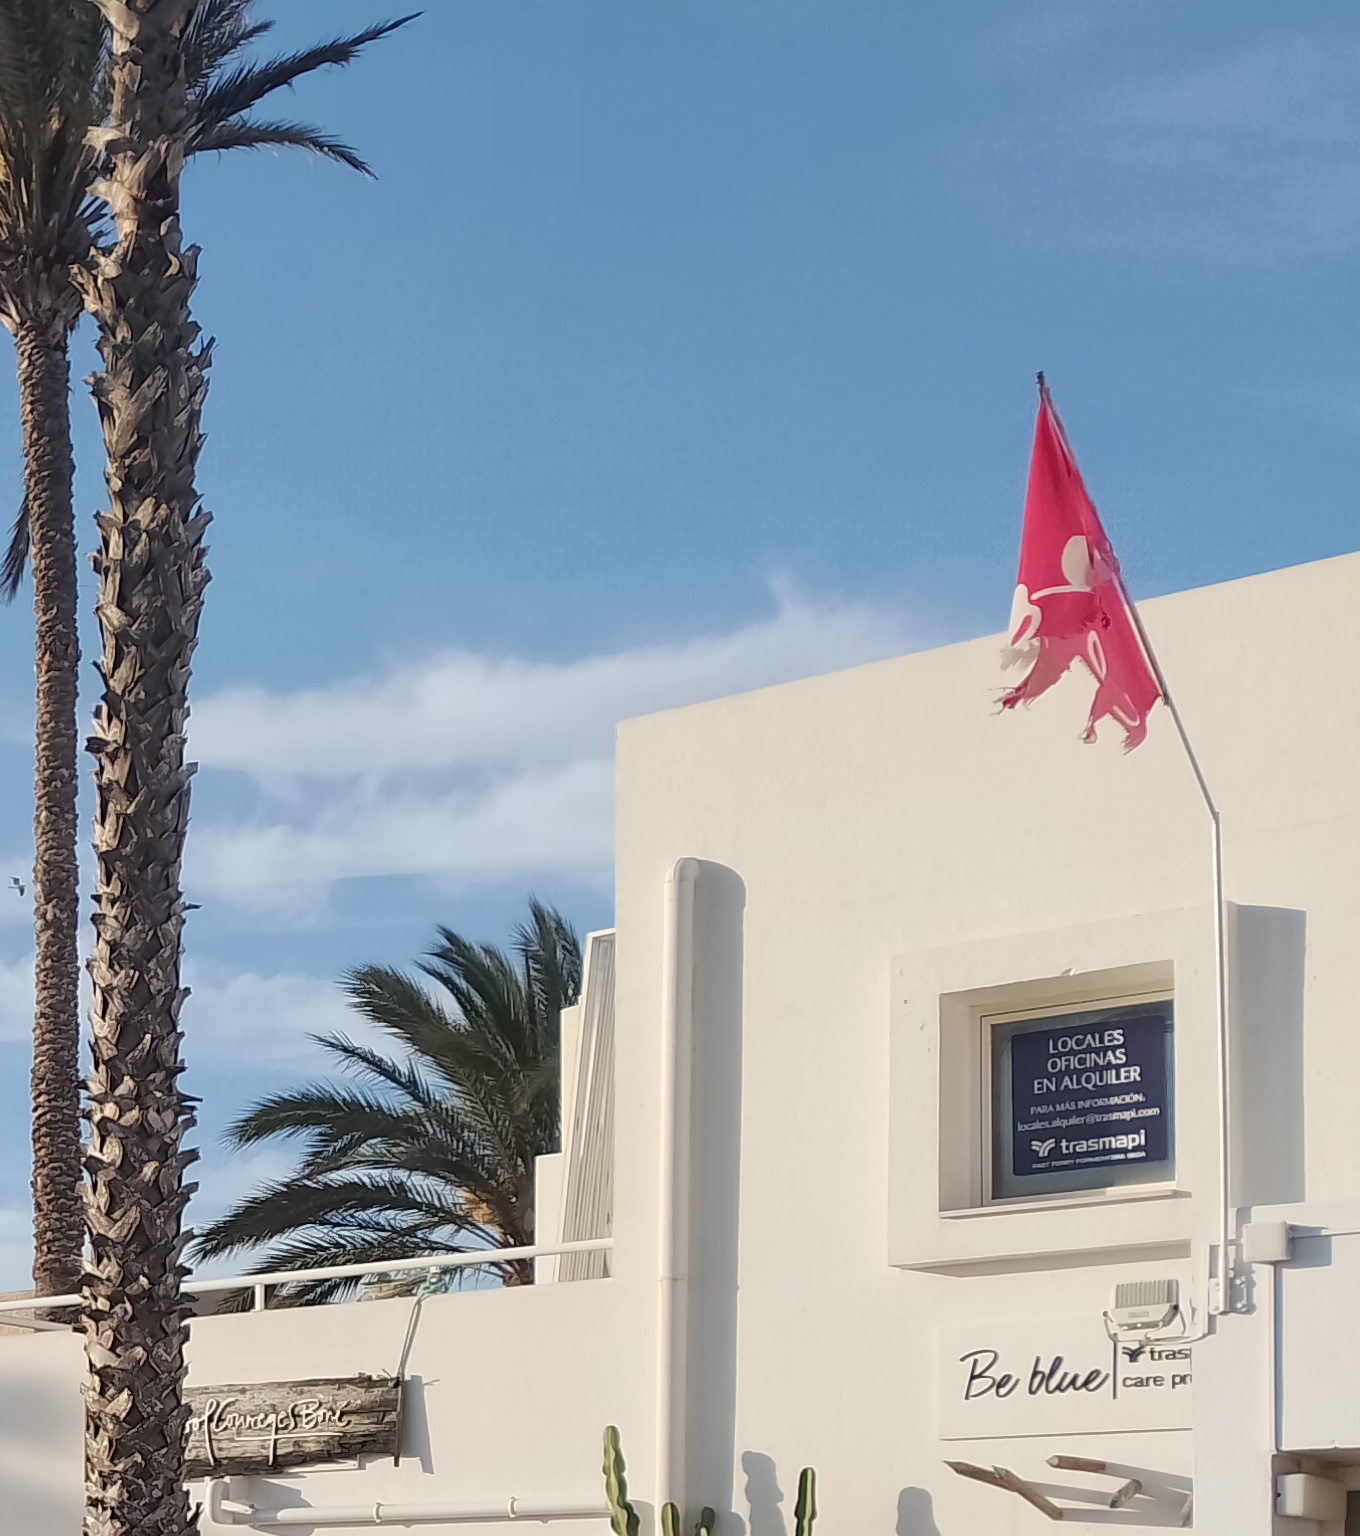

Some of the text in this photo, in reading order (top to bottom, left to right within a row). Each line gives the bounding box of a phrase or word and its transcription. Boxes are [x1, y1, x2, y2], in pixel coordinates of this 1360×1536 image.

[1048, 1029, 1125, 1054] LOCALES
[1047, 1048, 1127, 1073] OFICINAS
[1033, 1066, 1141, 1094] EN ALQUILER
[1017, 1106, 1161, 1132] locales.alquiler@trasmapi.com
[1030, 1103, 1054, 1115] PARA
[1055, 1100, 1076, 1112] MÁS
[1059, 1129, 1147, 1154] trasmapi
[1149, 1346, 1192, 1362] tras
[959, 1349, 1110, 1401] Be blue
[1122, 1373, 1193, 1390] care pr
